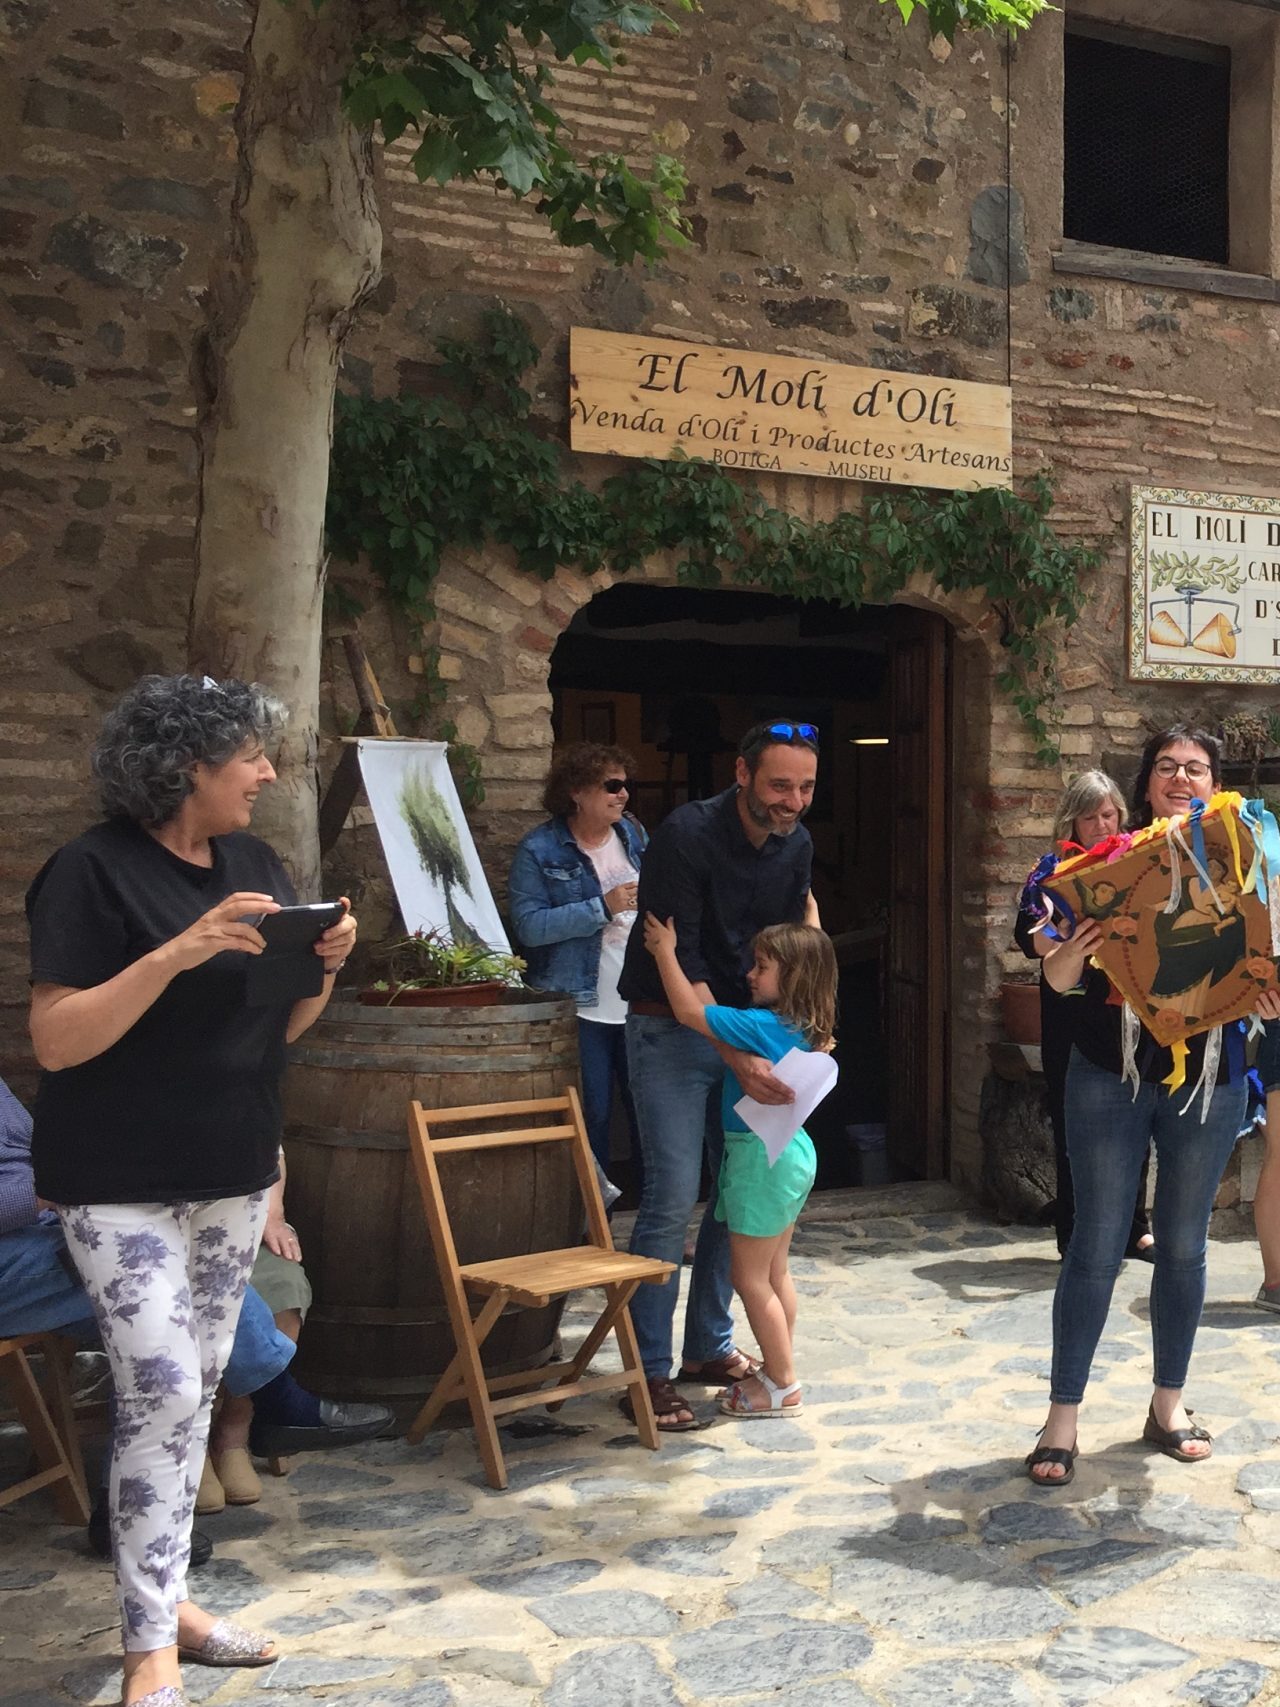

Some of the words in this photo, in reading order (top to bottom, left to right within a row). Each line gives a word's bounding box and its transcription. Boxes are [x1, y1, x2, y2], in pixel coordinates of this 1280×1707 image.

[638, 352, 699, 394] El
[716, 365, 828, 411] Molí
[571, 397, 666, 434] Venda
[751, 423, 761, 444] i
[768, 426, 896, 460] Productes
[904, 443, 1012, 472] Artesans
[713, 448, 783, 470] BOTIGA
[827, 461, 892, 482] MUSEU
[1151, 511, 1178, 538] EL
